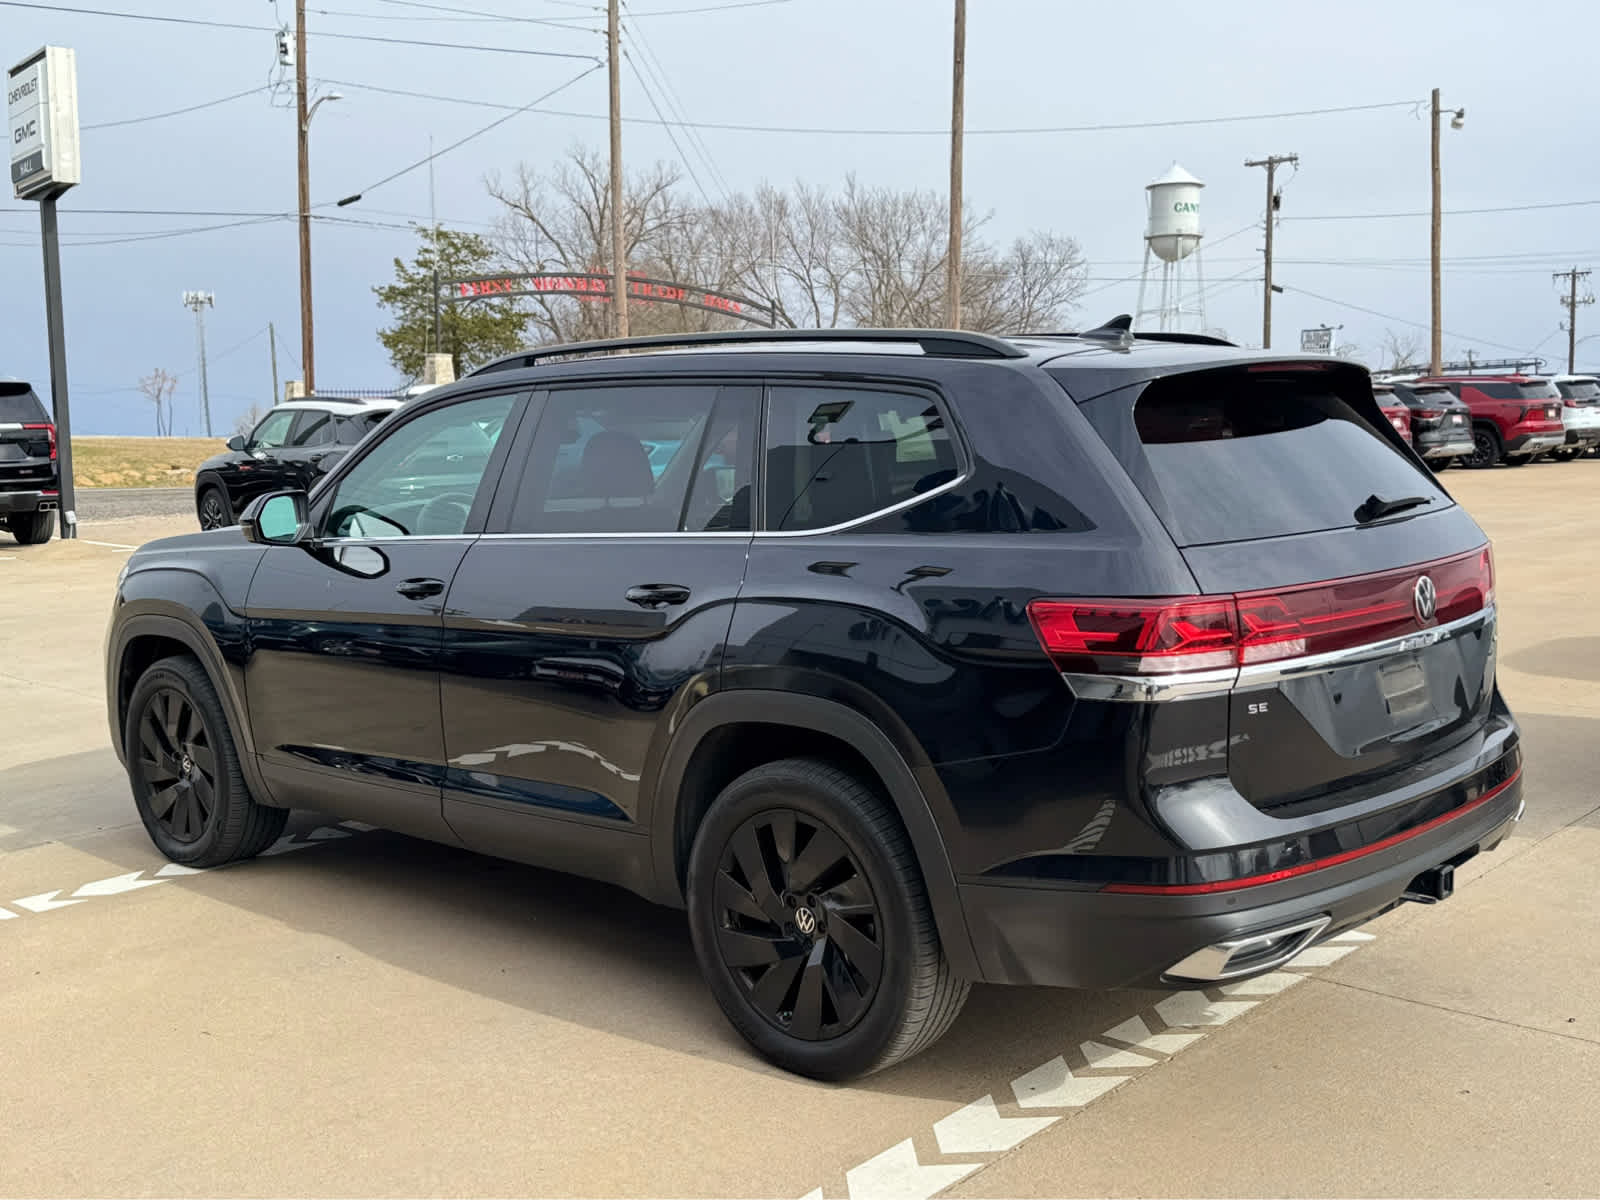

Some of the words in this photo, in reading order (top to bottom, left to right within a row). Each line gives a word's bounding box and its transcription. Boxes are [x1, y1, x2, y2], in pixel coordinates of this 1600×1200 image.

[8, 77, 38, 105] CHEVROLET
[15, 119, 36, 144] GMC
[1247, 701, 1269, 715] SE
